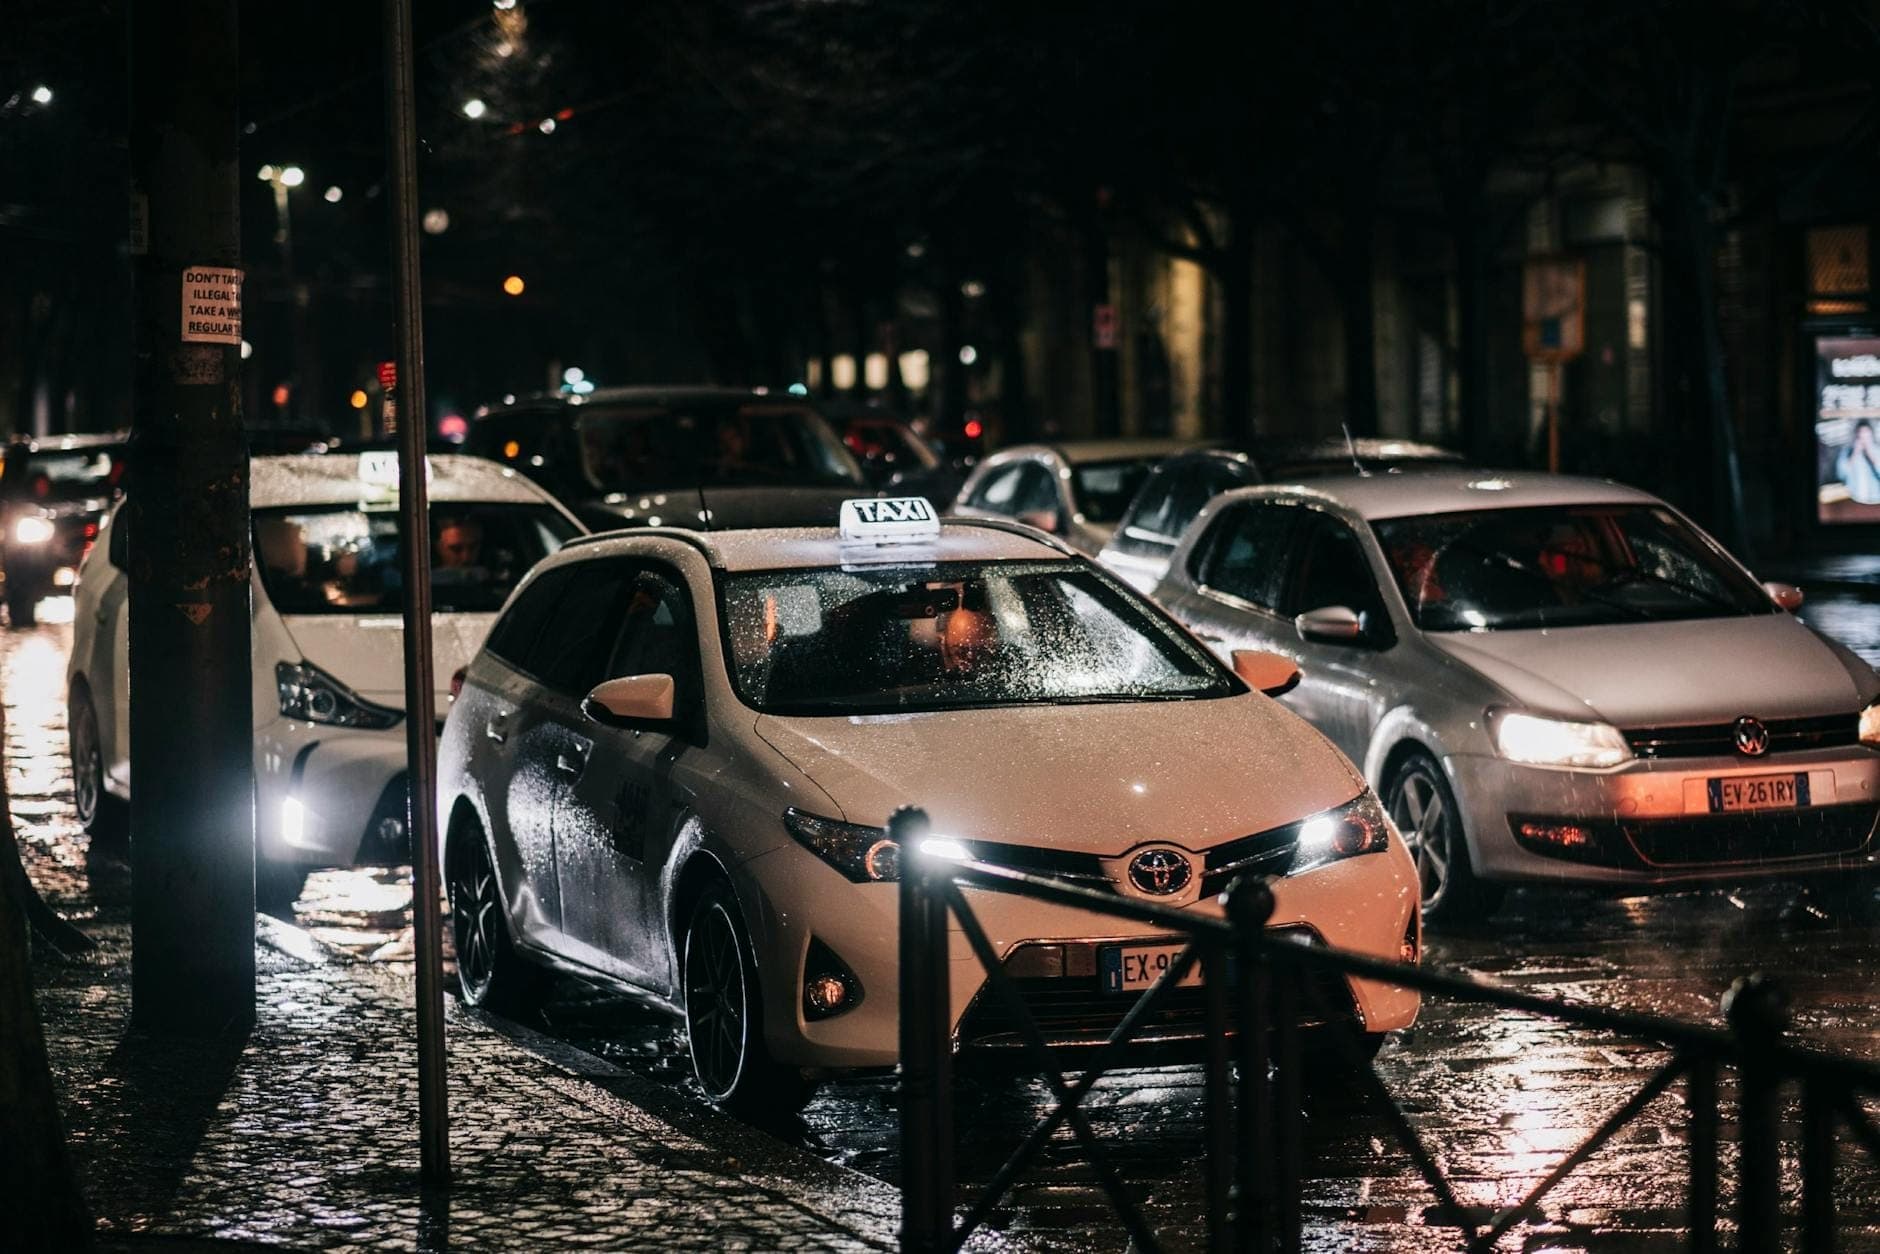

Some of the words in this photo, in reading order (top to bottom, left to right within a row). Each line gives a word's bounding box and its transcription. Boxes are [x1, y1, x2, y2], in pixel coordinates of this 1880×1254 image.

[186, 272, 220, 284] DON'T
[193, 289, 231, 300] ILLEGAL
[189, 304, 216, 316] TAKE
[218, 307, 225, 316] A
[188, 321, 233, 333] REGULAR
[852, 500, 930, 522] TAXI
[1748, 779, 1795, 804] 261RY
